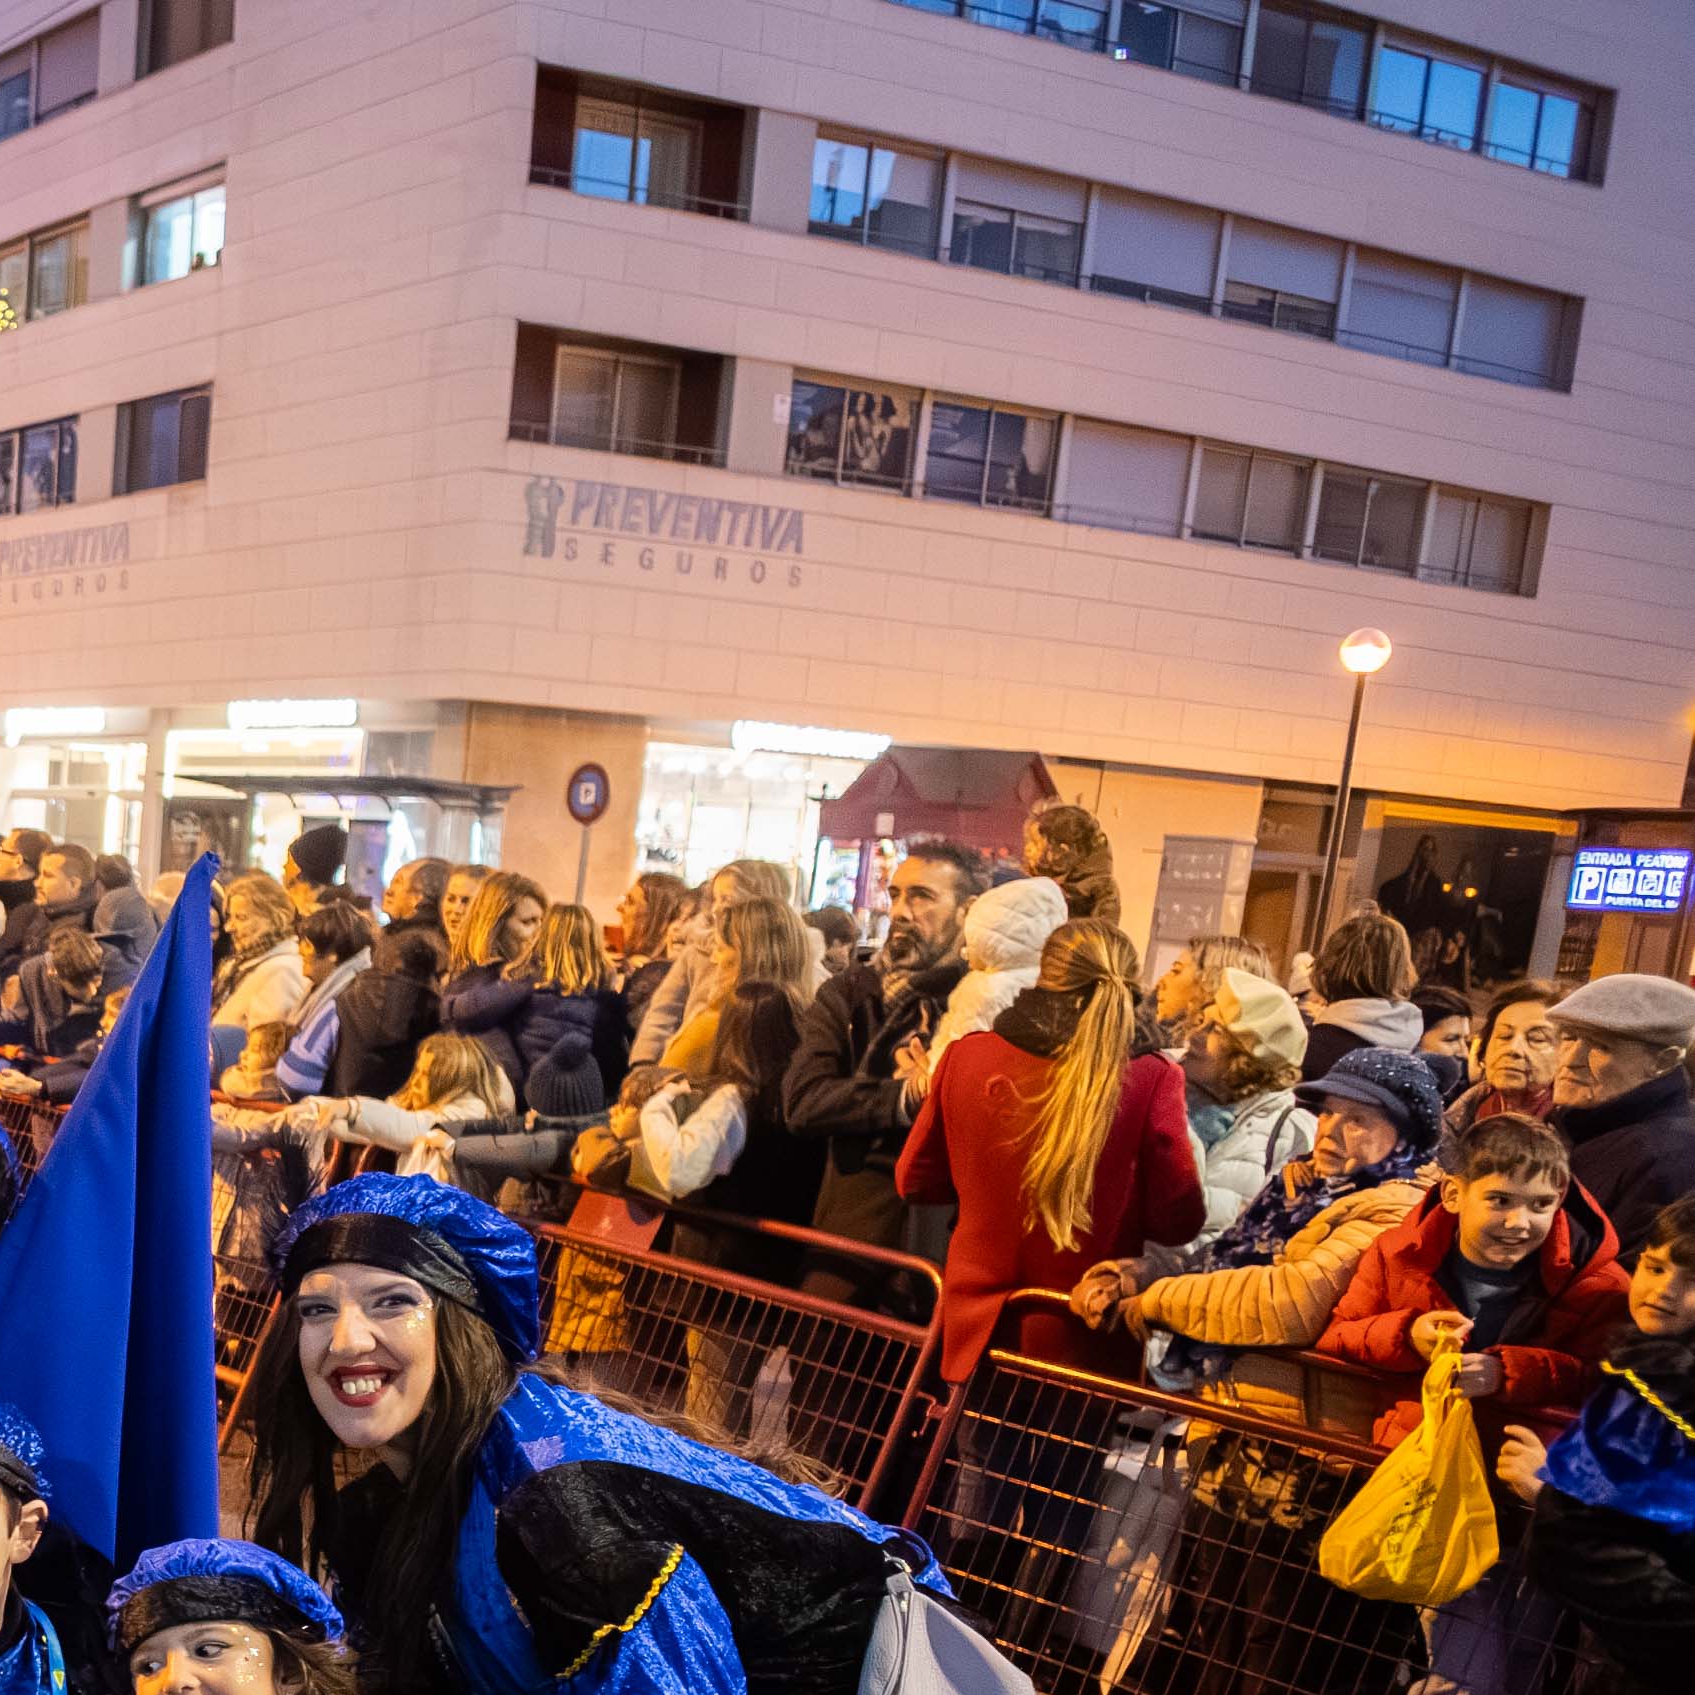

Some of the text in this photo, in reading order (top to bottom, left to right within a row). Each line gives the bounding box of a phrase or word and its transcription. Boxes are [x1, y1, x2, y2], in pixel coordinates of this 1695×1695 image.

[570, 480, 804, 554] PREVENTIVA
[564, 538, 802, 588] SEGUROS
[1579, 851, 1632, 866] ENTRADA
[1605, 896, 1644, 907] PUERTA
